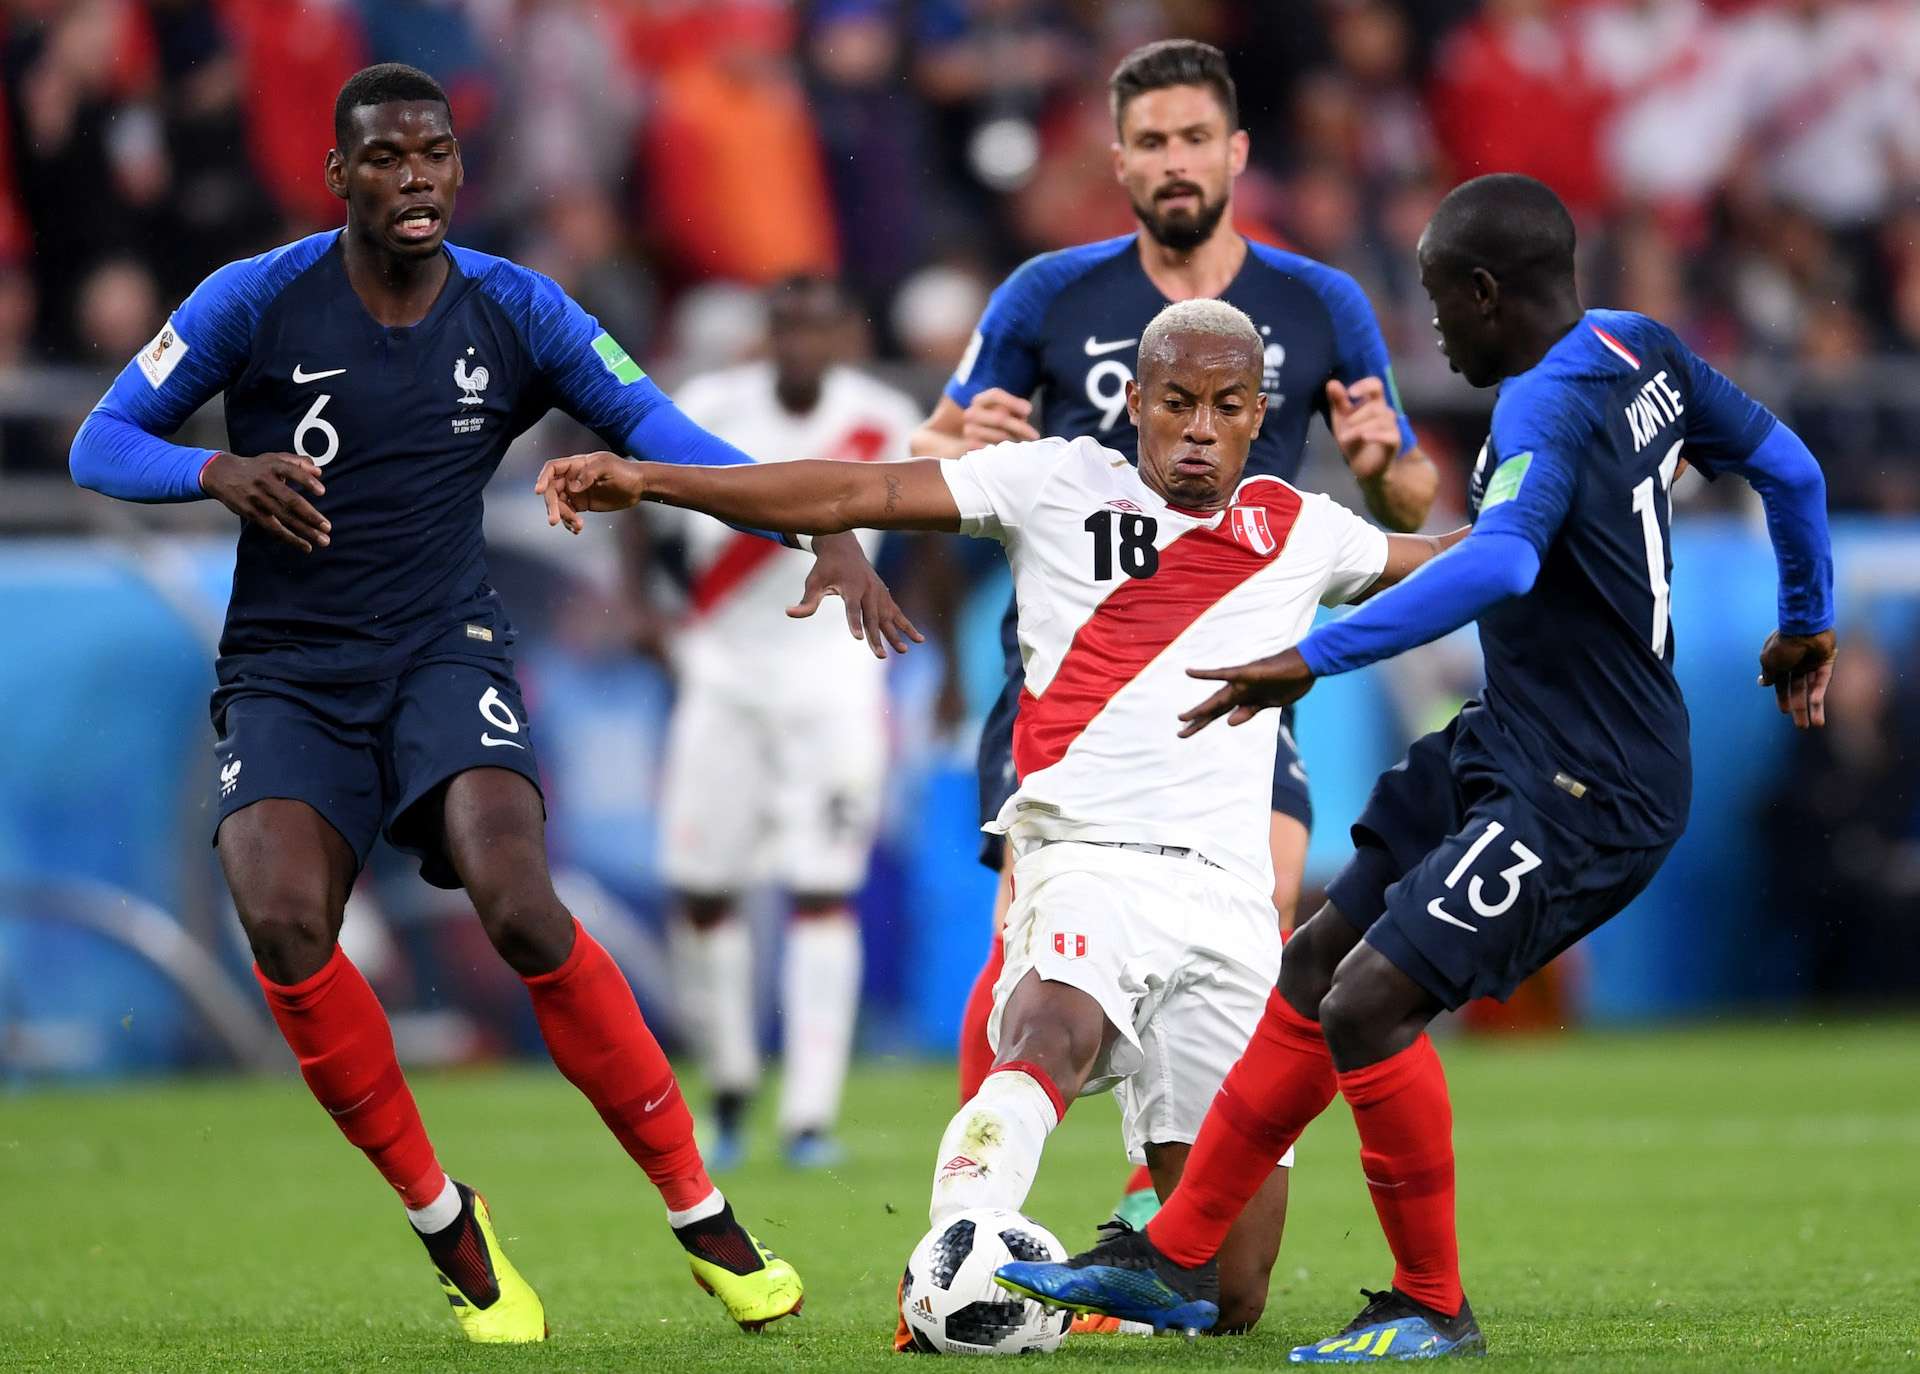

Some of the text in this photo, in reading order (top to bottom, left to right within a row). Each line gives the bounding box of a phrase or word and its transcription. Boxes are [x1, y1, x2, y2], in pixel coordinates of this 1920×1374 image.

[293, 393, 339, 467] 6
[1086, 360, 1134, 432] 9
[1084, 509, 1159, 581] 18
[478, 686, 520, 734] 6
[1444, 820, 1543, 918] 13
[911, 1305, 938, 1325] adidas
